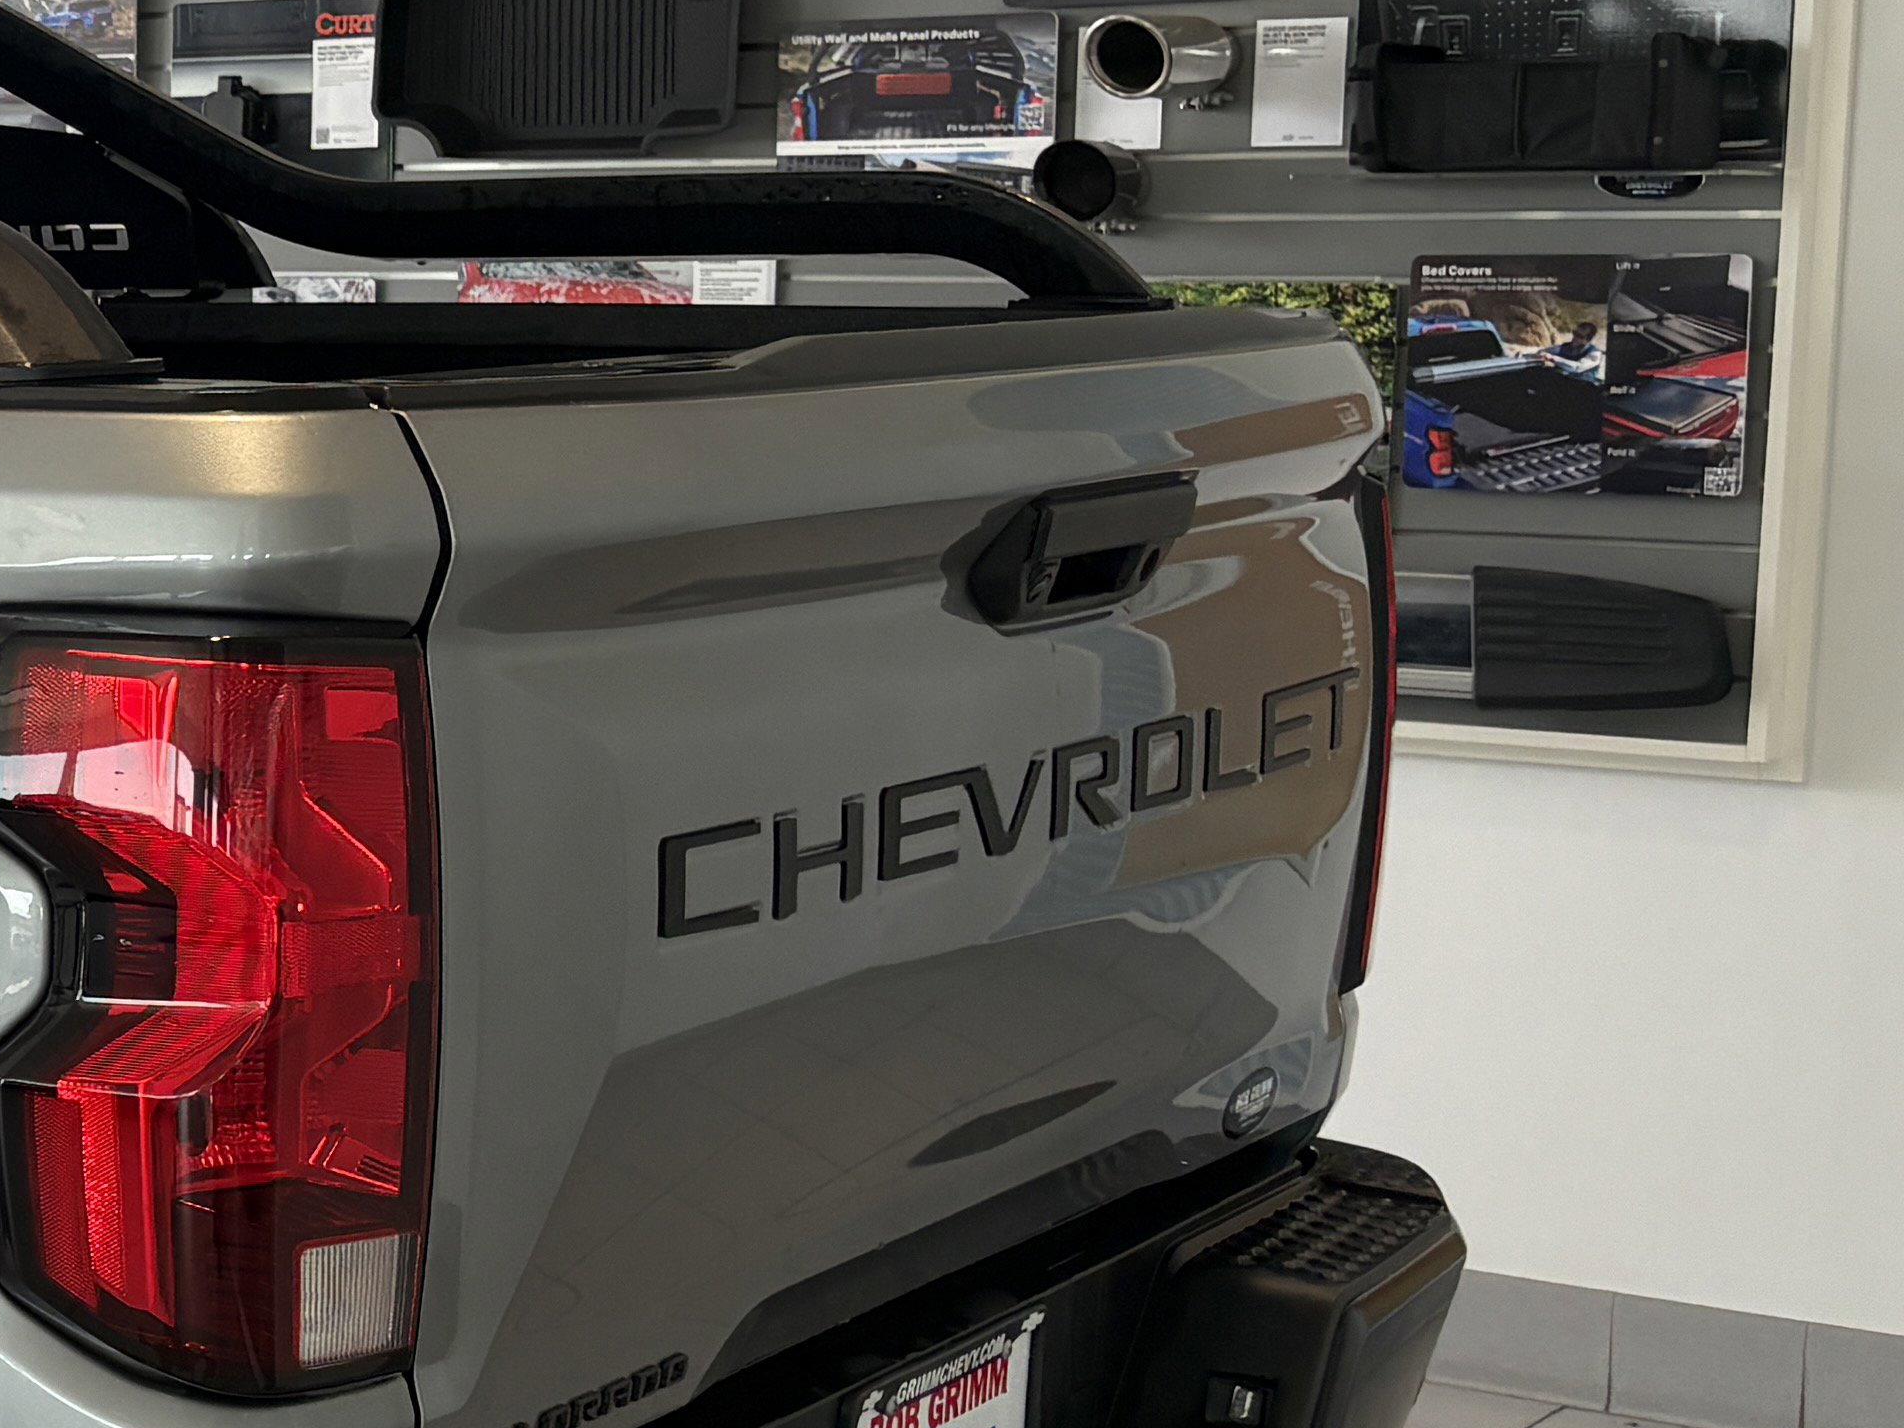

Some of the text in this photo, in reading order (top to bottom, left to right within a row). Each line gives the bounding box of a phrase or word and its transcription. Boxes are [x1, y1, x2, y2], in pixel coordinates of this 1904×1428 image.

[315, 12, 376, 36] CURT
[792, 35, 822, 47] Utility
[824, 33, 848, 44] Wall
[848, 33, 868, 43] and
[900, 30, 929, 41] Panel
[931, 29, 980, 40] Products
[1421, 265, 1492, 276] Bed Covers
[657, 666, 1360, 939] CHEVROLET
[896, 1333, 1006, 1404] GRIMMCHEVY.COM
